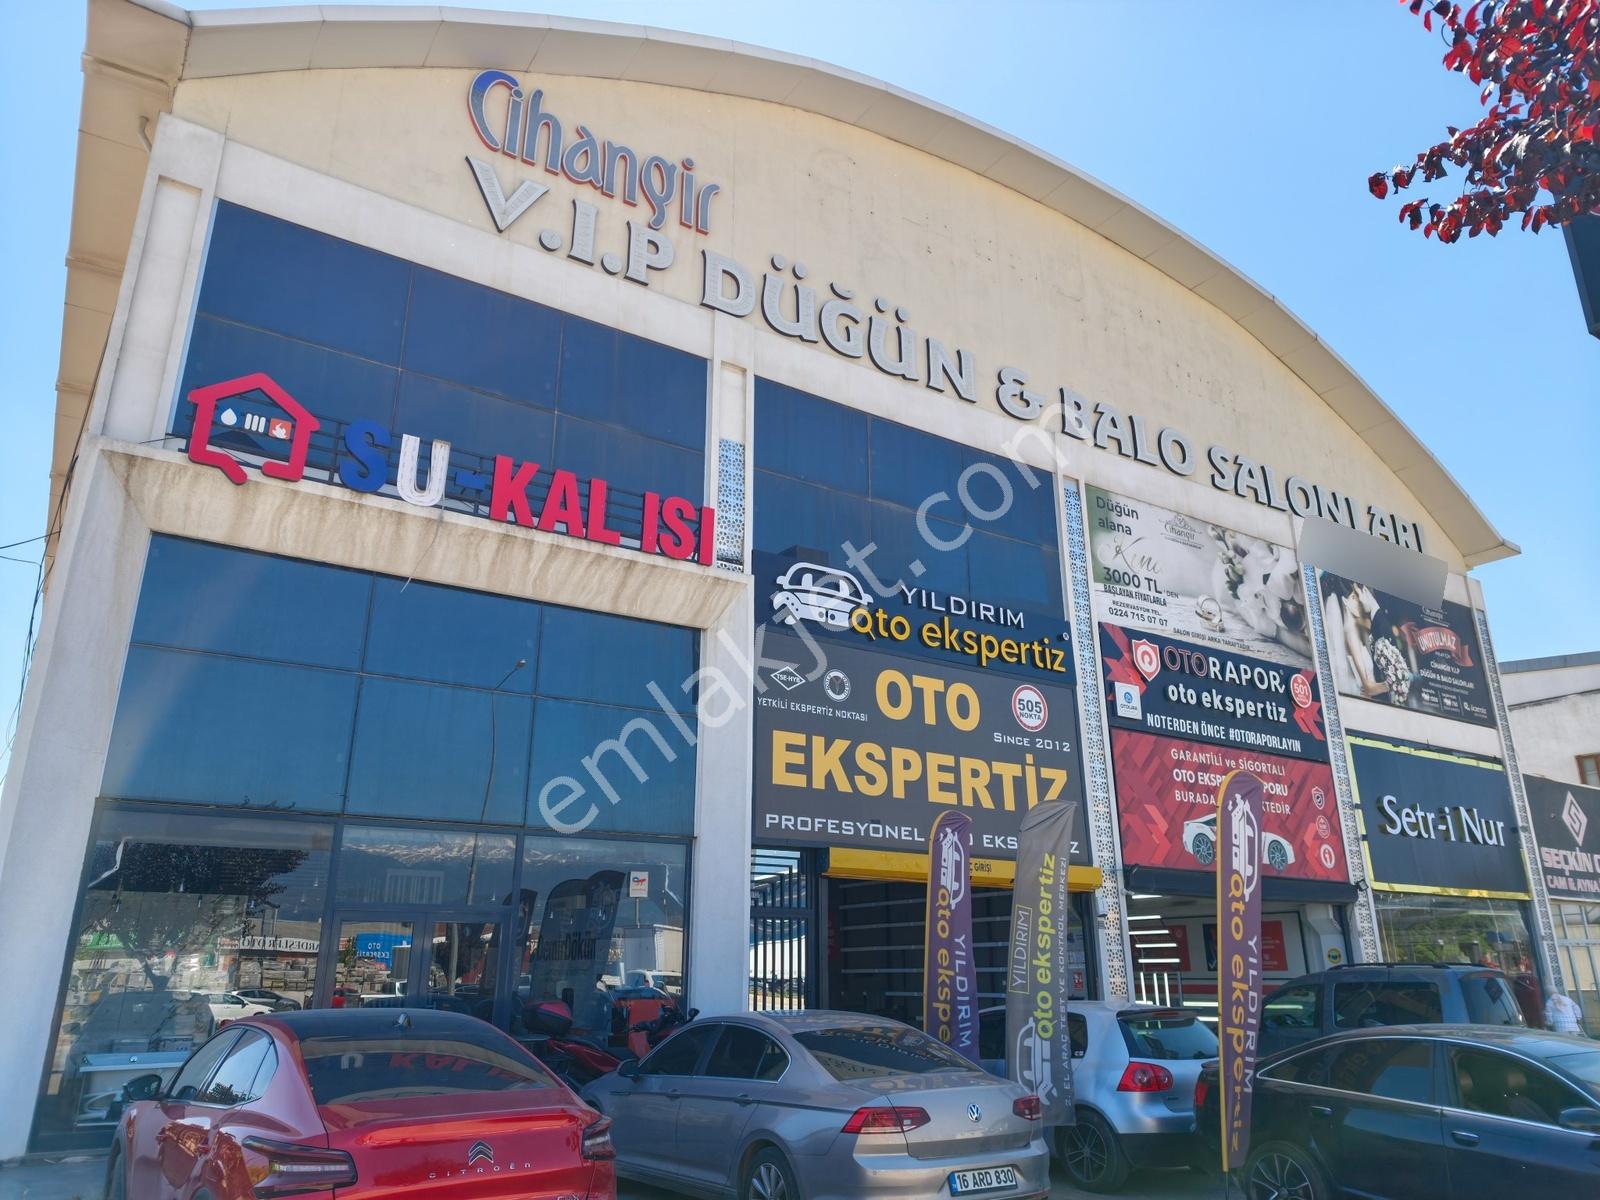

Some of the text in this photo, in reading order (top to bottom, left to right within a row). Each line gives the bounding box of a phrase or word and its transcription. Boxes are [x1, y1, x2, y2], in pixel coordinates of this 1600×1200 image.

[467, 69, 721, 236] Cihangir
[464, 155, 675, 287] V.I.P
[700, 248, 978, 404] DÜĞÜN
[995, 366, 1047, 421] &
[1059, 386, 1199, 478] BALO
[1096, 495, 1139, 520] Düğün
[1098, 517, 1132, 535] alana
[1103, 566, 1141, 589] 3000
[1144, 577, 1163, 595] TL
[901, 584, 1026, 630] YILDIRIM
[1108, 607, 1168, 627] 0224 715 07 07
[921, 615, 1068, 673] ekspertiz
[1417, 630, 1457, 652] UNUTULMAZ
[1163, 645, 1286, 694] OTORAPOR
[757, 697, 868, 722] YETKİLİ EKSPERTİZ NOKTASI
[875, 668, 981, 732] OTO
[1016, 698, 1043, 715] 505
[1018, 711, 1042, 722] NOKTA
[1167, 683, 1288, 724] oto ekspertiz
[1034, 736, 1071, 752] 2012
[1146, 713, 1302, 754] NOTERDEN ÖNCE #OTORAPORLAYIN
[771, 729, 1069, 812] EKSPERTİZ
[1170, 747, 1286, 777] GARANTİLİ ve SİGORTALI
[1172, 768, 1196, 783] OTO
[1175, 789, 1217, 806] BURADA
[764, 813, 925, 842] PROFESYONEL
[1382, 794, 1506, 847] Setr-i Nur
[1540, 846, 1595, 876] SEÇKİN
[1057, 857, 1067, 911] MERKEZİ
[1032, 852, 1057, 985] ekspertiz
[1012, 910, 1031, 988] YILDIRIM
[1056, 915, 1066, 973] KONTROL
[954, 934, 972, 1048] YILDIRIM
[1058, 978, 1066, 994] VE
[1059, 998, 1067, 1031] TEST
[1243, 935, 1258, 1094] YILDIRIM
[1226, 953, 1249, 1153] ekspertiz
[957, 1168, 1014, 1190] 16 ARD 830
